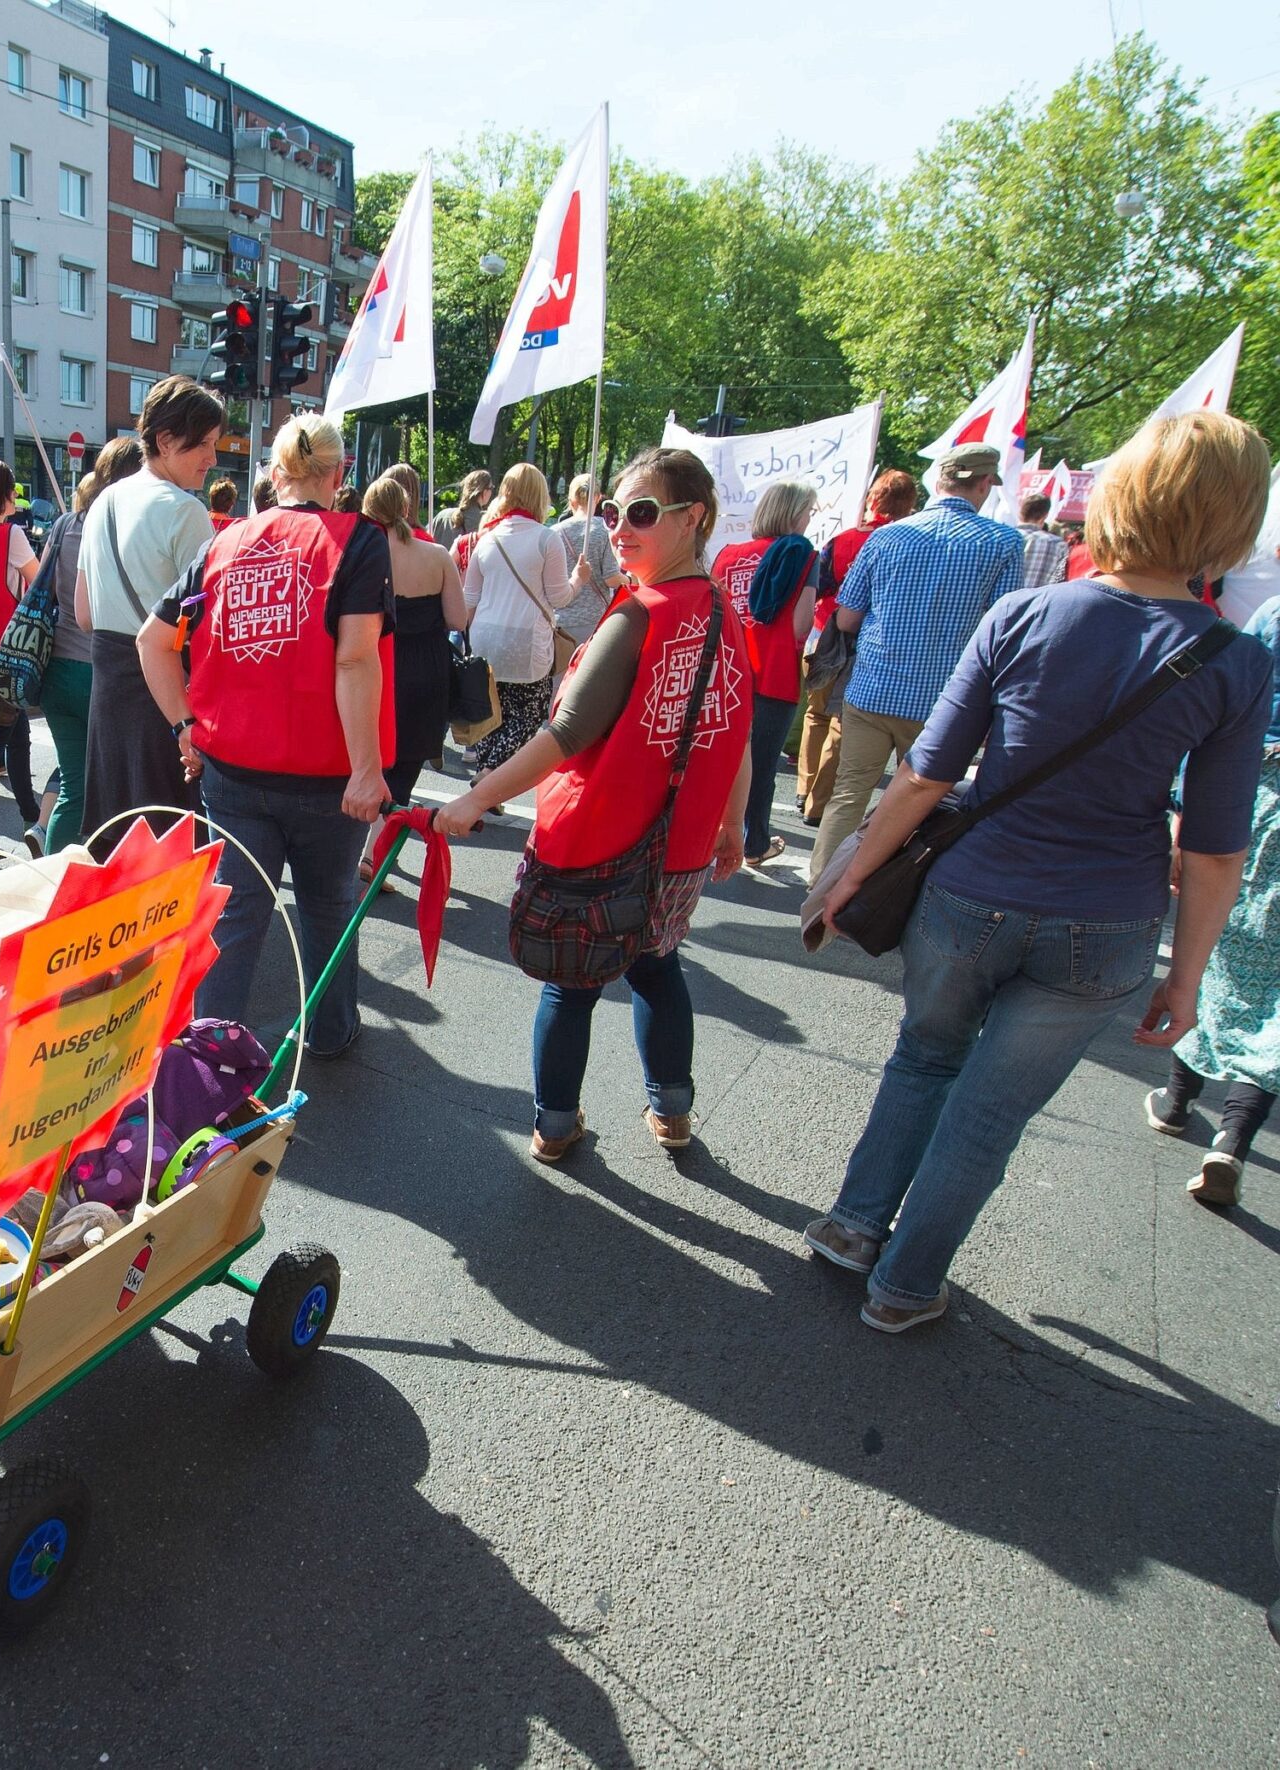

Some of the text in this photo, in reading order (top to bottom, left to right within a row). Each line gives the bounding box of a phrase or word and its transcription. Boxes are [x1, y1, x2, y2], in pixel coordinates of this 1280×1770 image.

[227, 563, 292, 586] RICHTIG
[227, 580, 275, 609] GUT
[228, 602, 292, 625] AUFWERTEN
[228, 614, 291, 642] JETZT!
[108, 922, 138, 949] On
[142, 898, 179, 933] Fire
[29, 980, 163, 1068] Ausgebrannt
[84, 1051, 110, 1079] im
[8, 1047, 144, 1147] Jugendamt!!!
